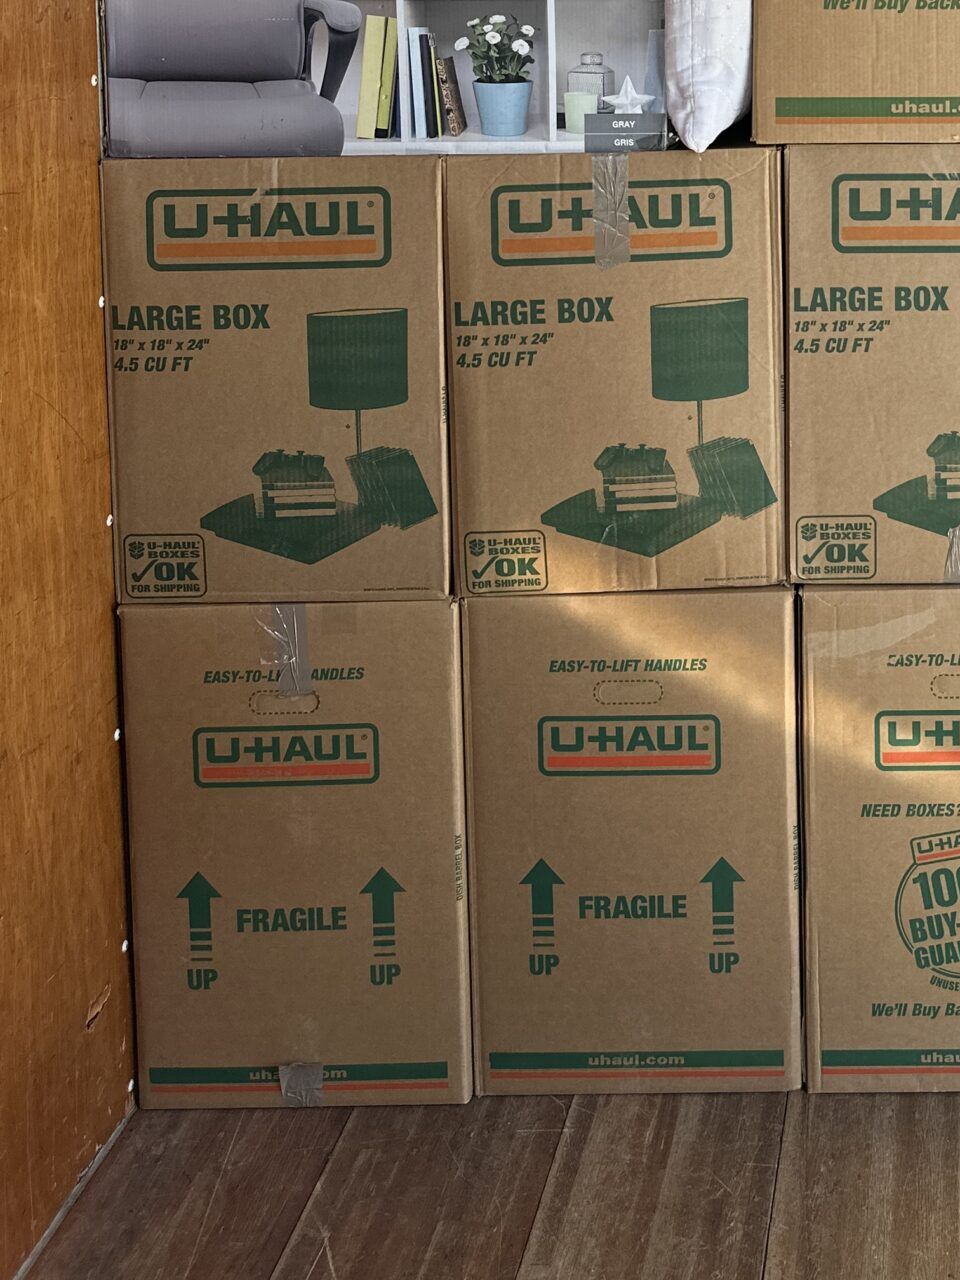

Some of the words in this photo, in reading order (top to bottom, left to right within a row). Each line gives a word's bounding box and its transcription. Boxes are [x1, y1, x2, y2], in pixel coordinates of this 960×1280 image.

[612, 120, 635, 129] GRAY
[614, 138, 634, 147] GRIS
[164, 200, 375, 238] U-HAUL
[508, 192, 716, 233] U-AUL
[793, 287, 883, 313] LARGE
[894, 286, 949, 311] BOX
[112, 305, 202, 331] LARGE
[213, 304, 270, 329] BOX
[454, 298, 546, 327] LARGE
[557, 296, 614, 324] BOX
[819, 322, 828, 332] x
[857, 322, 866, 331] x
[794, 338, 820, 353] 4.5
[825, 338, 847, 353] CU
[852, 338, 874, 353] FT
[549, 659, 641, 673] EASY-TO-LIFT
[643, 658, 708, 672] HANDLES
[206, 734, 367, 763] U-HAUL
[551, 725, 708, 752] U-HAUL
[578, 895, 687, 920] FRAGILE
[236, 906, 348, 933] FRAGILE
[529, 954, 560, 975] UP
[709, 952, 740, 974] UP
[187, 968, 219, 991] UP
[369, 964, 401, 986] UP
[588, 1054, 685, 1066] uhaul.com
